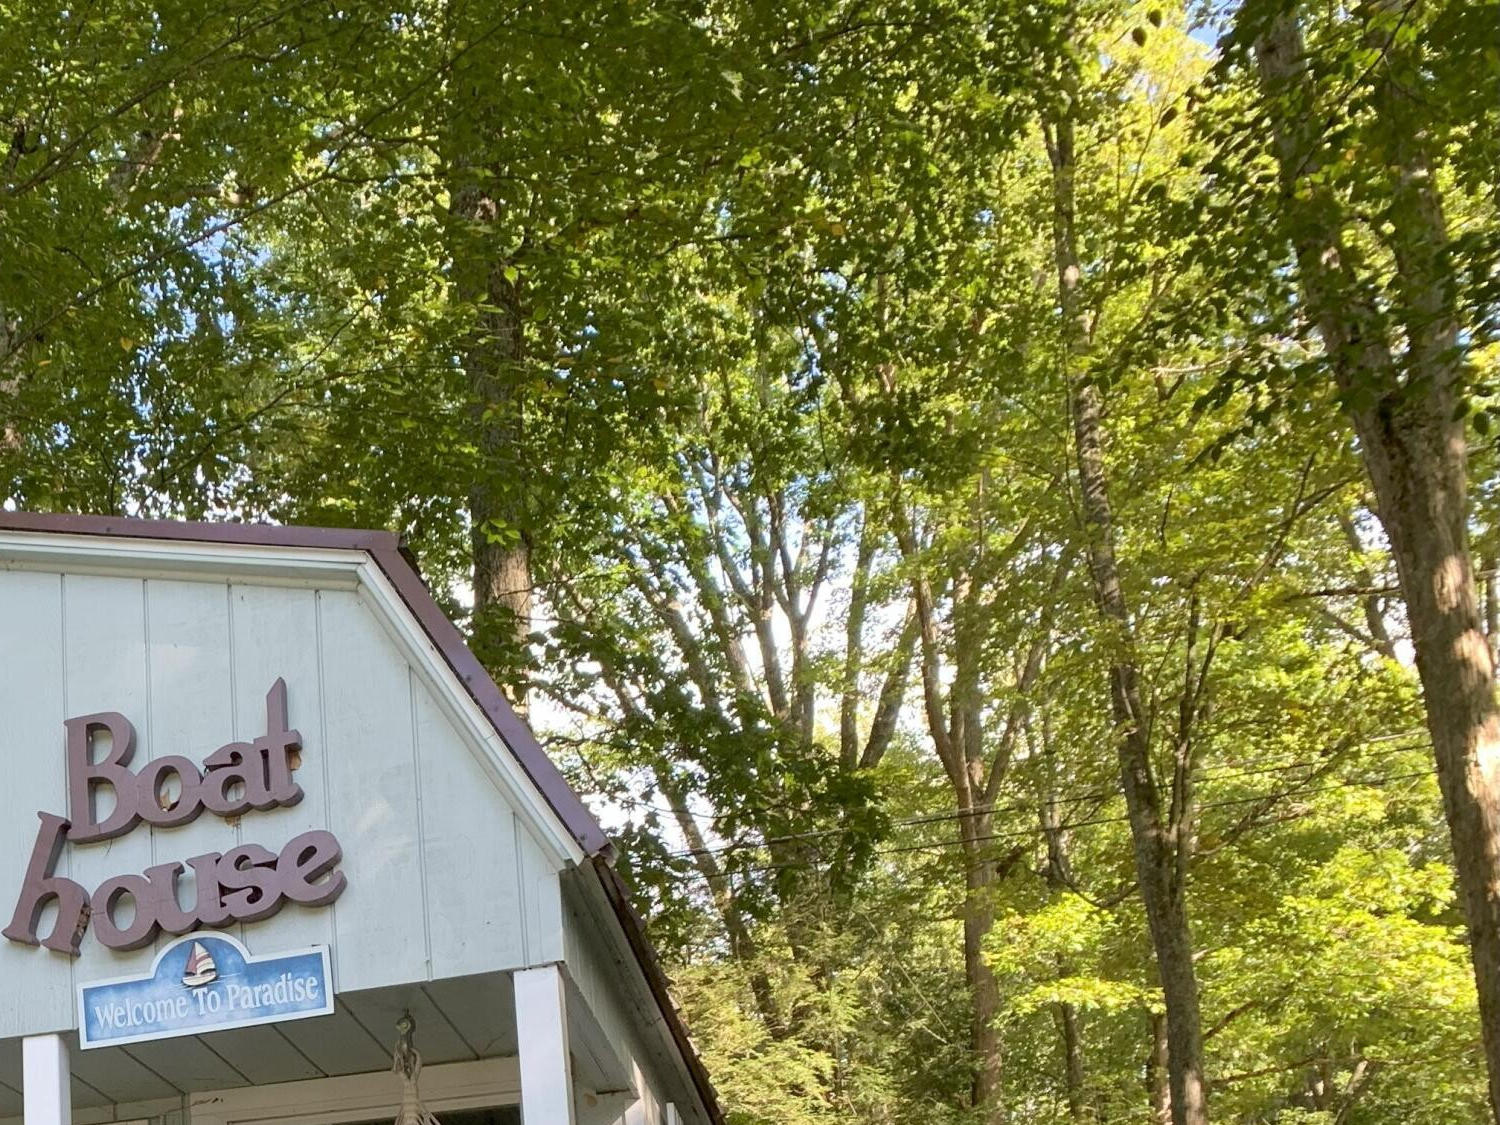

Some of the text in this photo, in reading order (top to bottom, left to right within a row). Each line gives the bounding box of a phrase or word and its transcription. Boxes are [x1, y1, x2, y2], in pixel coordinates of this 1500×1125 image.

[63, 677, 305, 844] Boat
[1, 811, 348, 957] house
[94, 972, 319, 1030] Welcome To Paradise
